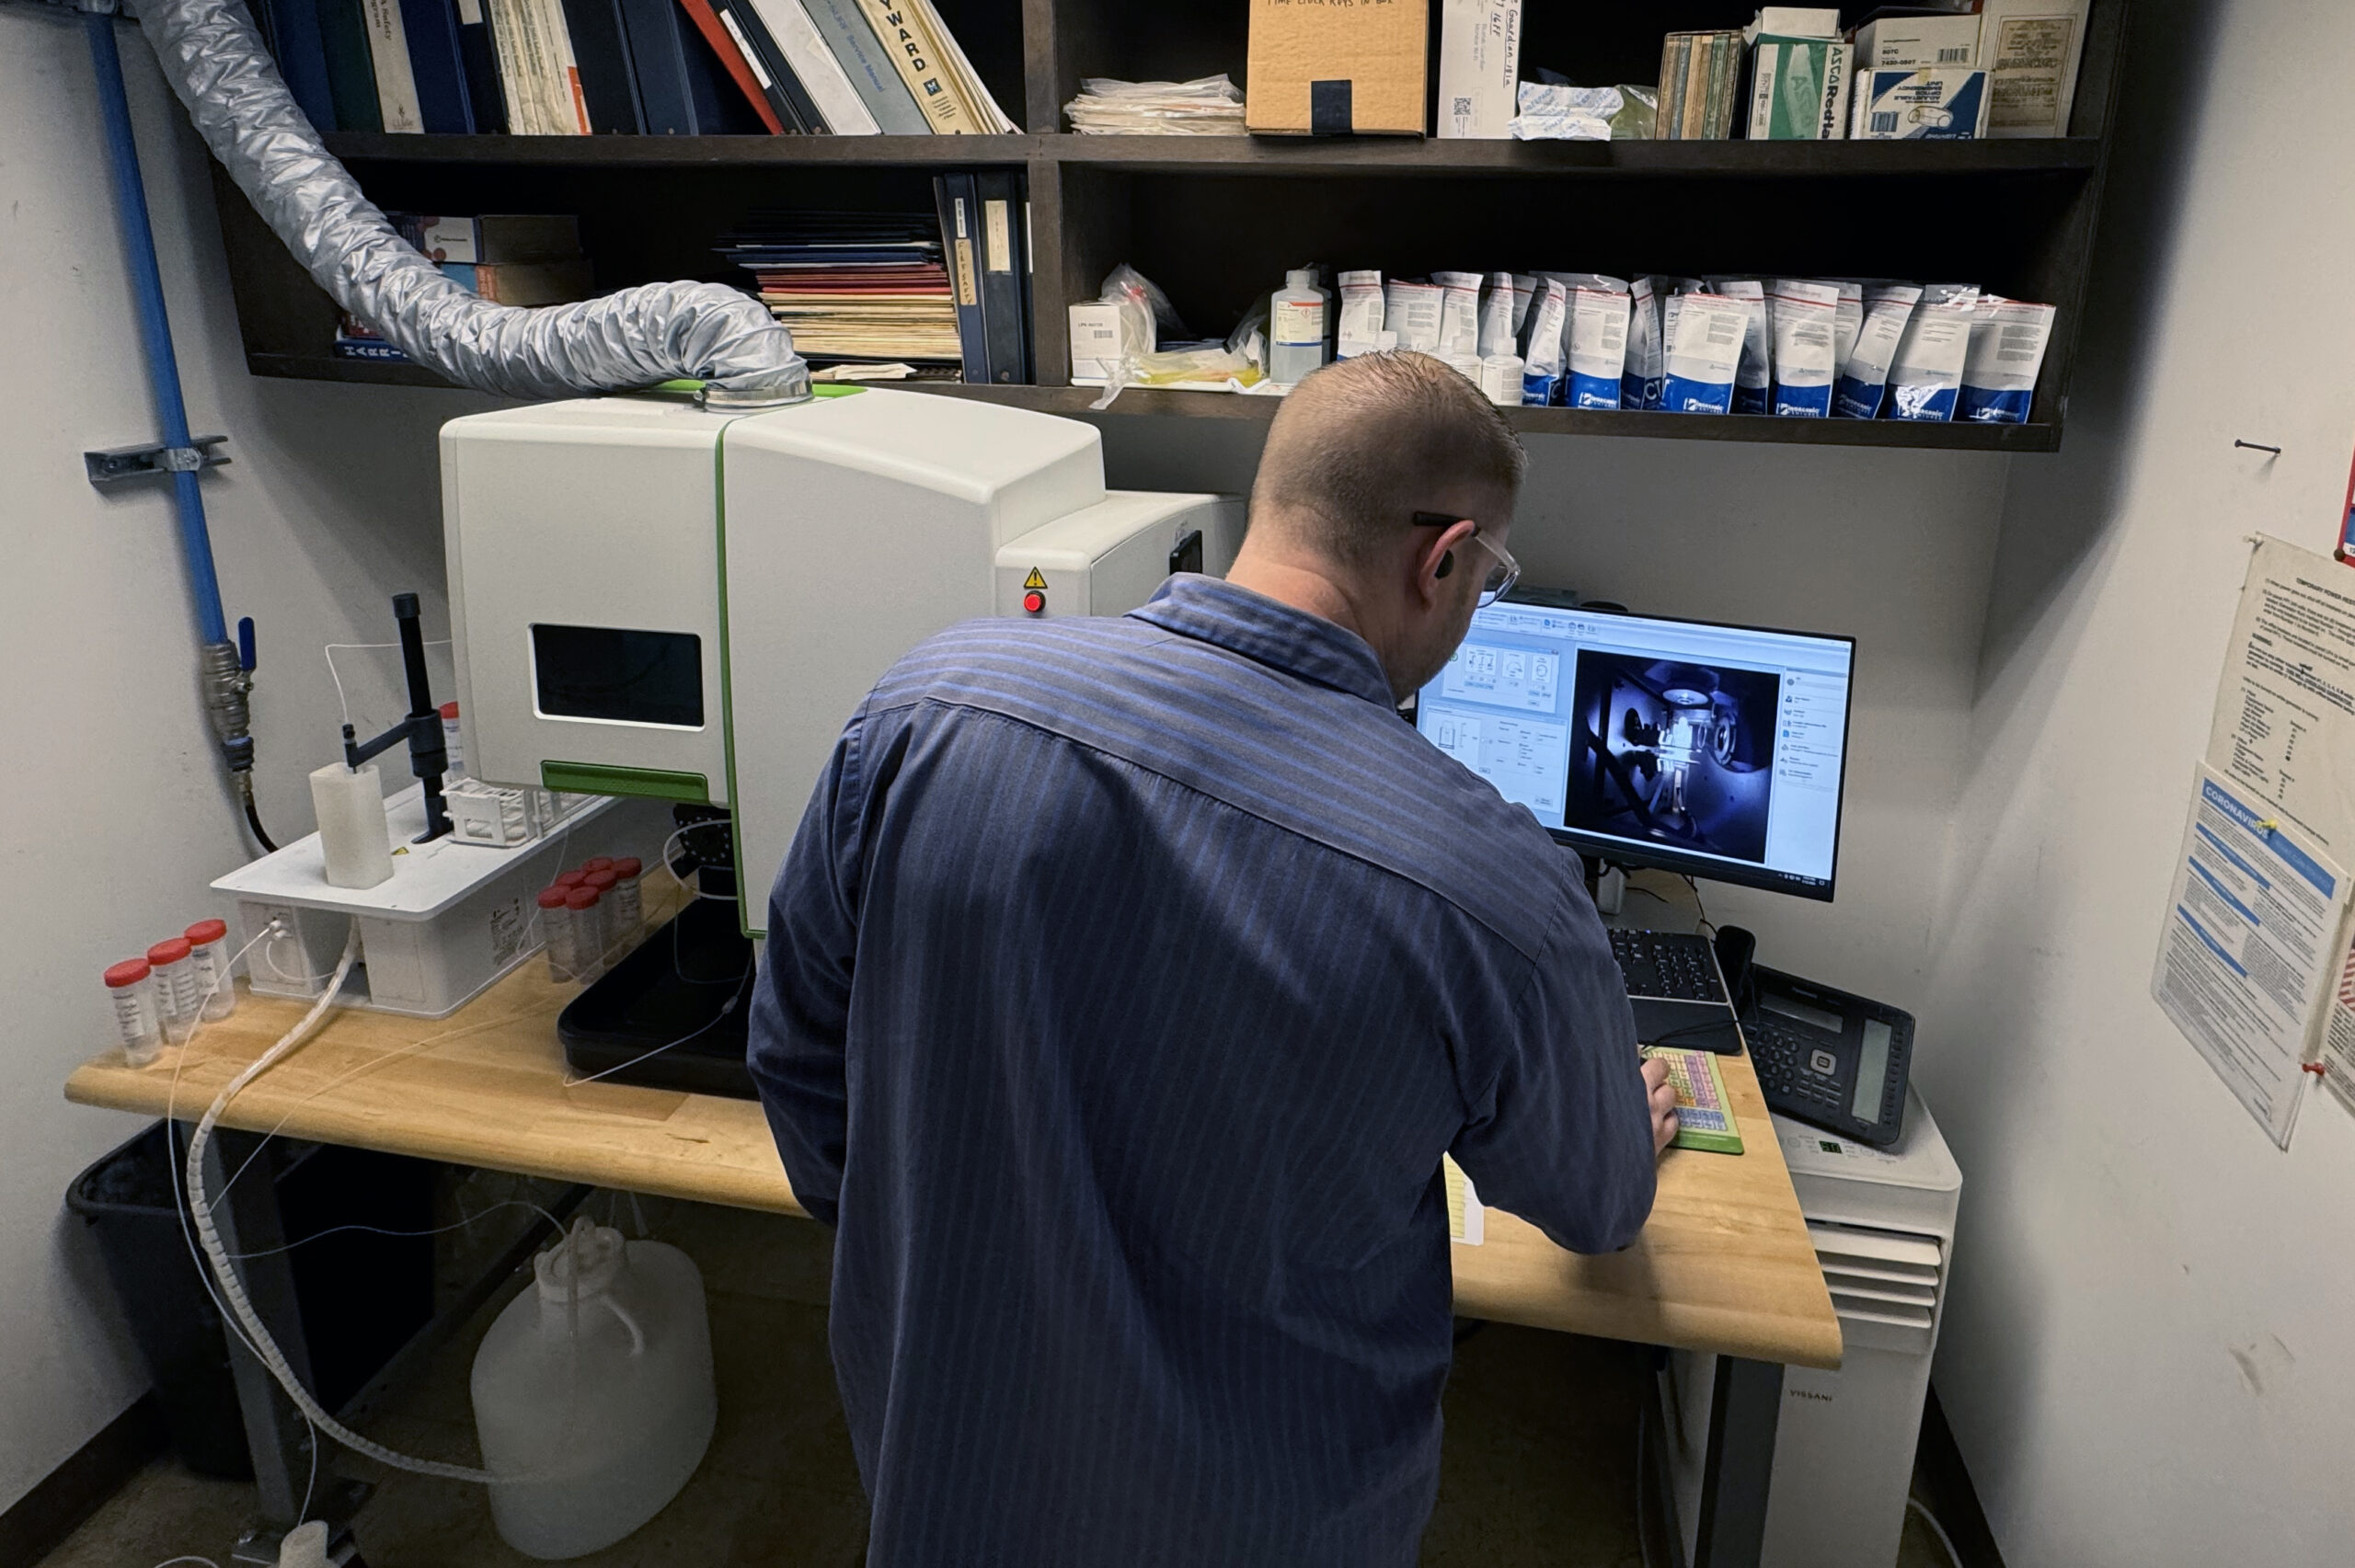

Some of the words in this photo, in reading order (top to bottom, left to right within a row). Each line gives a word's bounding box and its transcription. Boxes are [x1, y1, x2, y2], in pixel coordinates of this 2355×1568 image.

[845, 34, 867, 65] Service
[864, 63, 885, 93] Manual
[343, 346, 409, 359] HARRI
[1789, 1389, 1832, 1402] VISSANI
